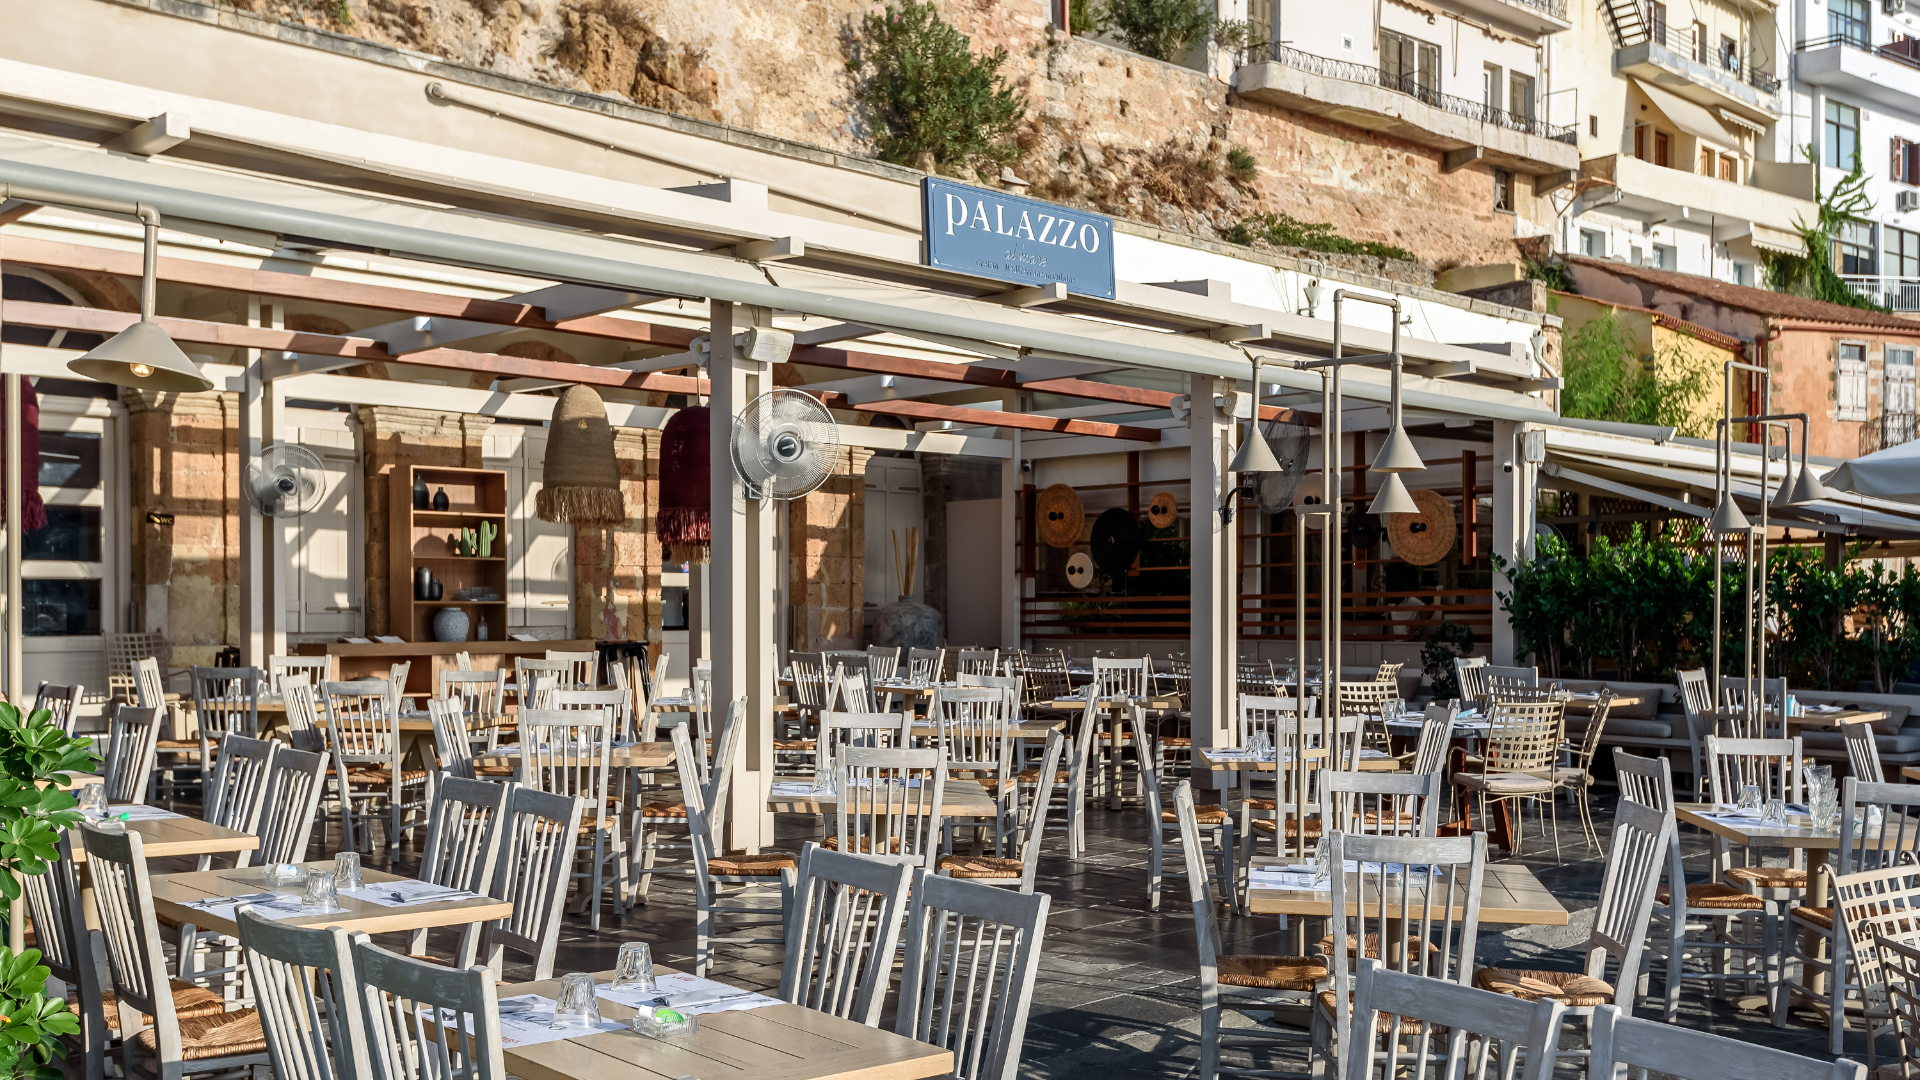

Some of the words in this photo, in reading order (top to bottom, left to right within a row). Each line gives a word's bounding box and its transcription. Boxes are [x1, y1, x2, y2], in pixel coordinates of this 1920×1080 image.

[944, 193, 1100, 253] PALAZZO
[976, 258, 999, 270] Cretan
[1005, 264, 1052, 280] Mediterranean
[1053, 272, 1076, 284] Cuisine
[160, 517, 173, 525] WC
